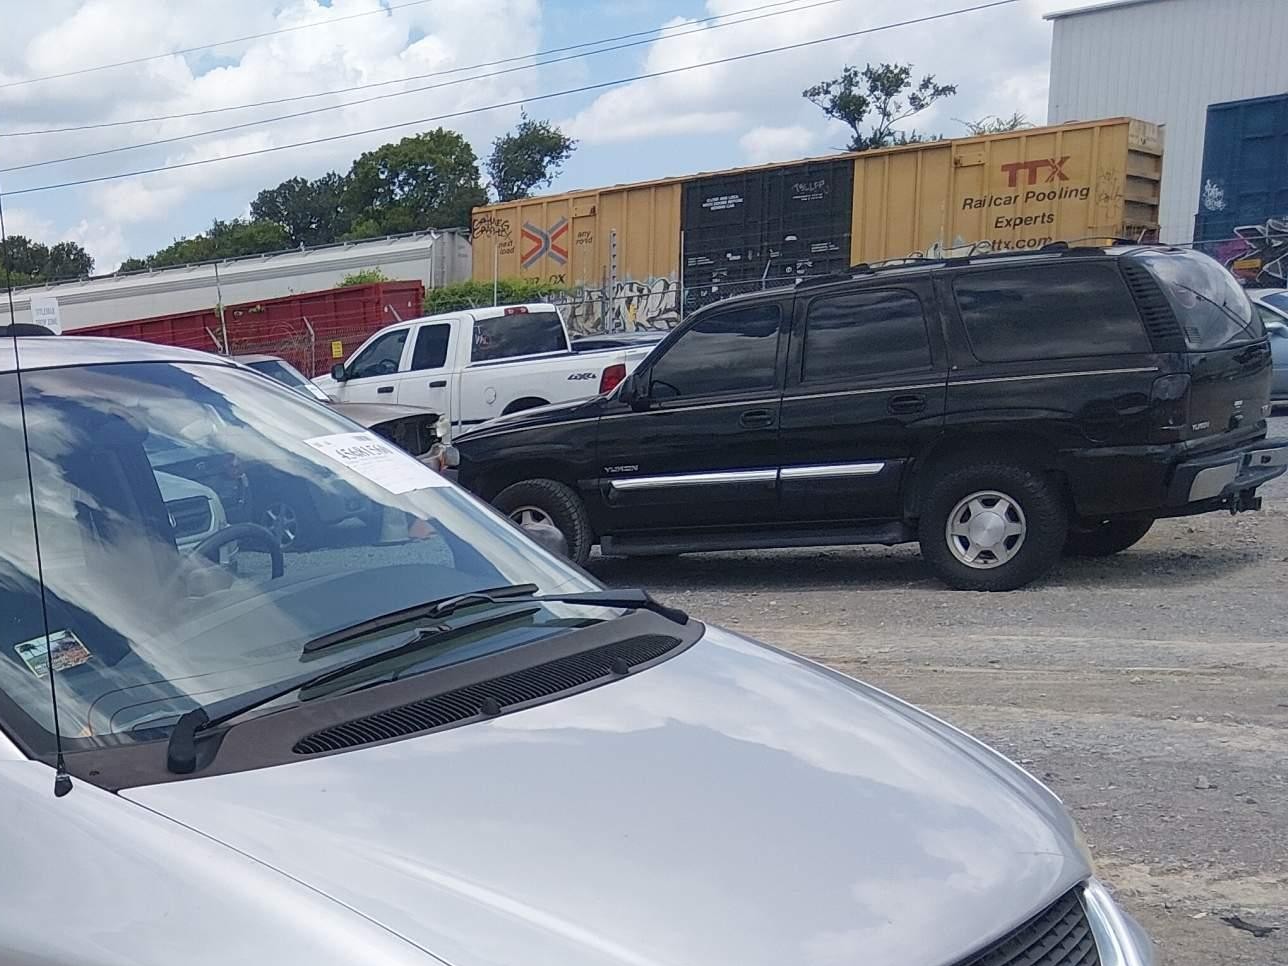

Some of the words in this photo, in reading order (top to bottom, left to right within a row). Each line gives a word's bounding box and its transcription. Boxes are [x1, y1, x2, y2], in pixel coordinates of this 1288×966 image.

[1001, 156, 1071, 188] TTX
[962, 193, 1020, 210] Railcar
[1024, 186, 1090, 203] Pooling
[995, 212, 1055, 230] Experts
